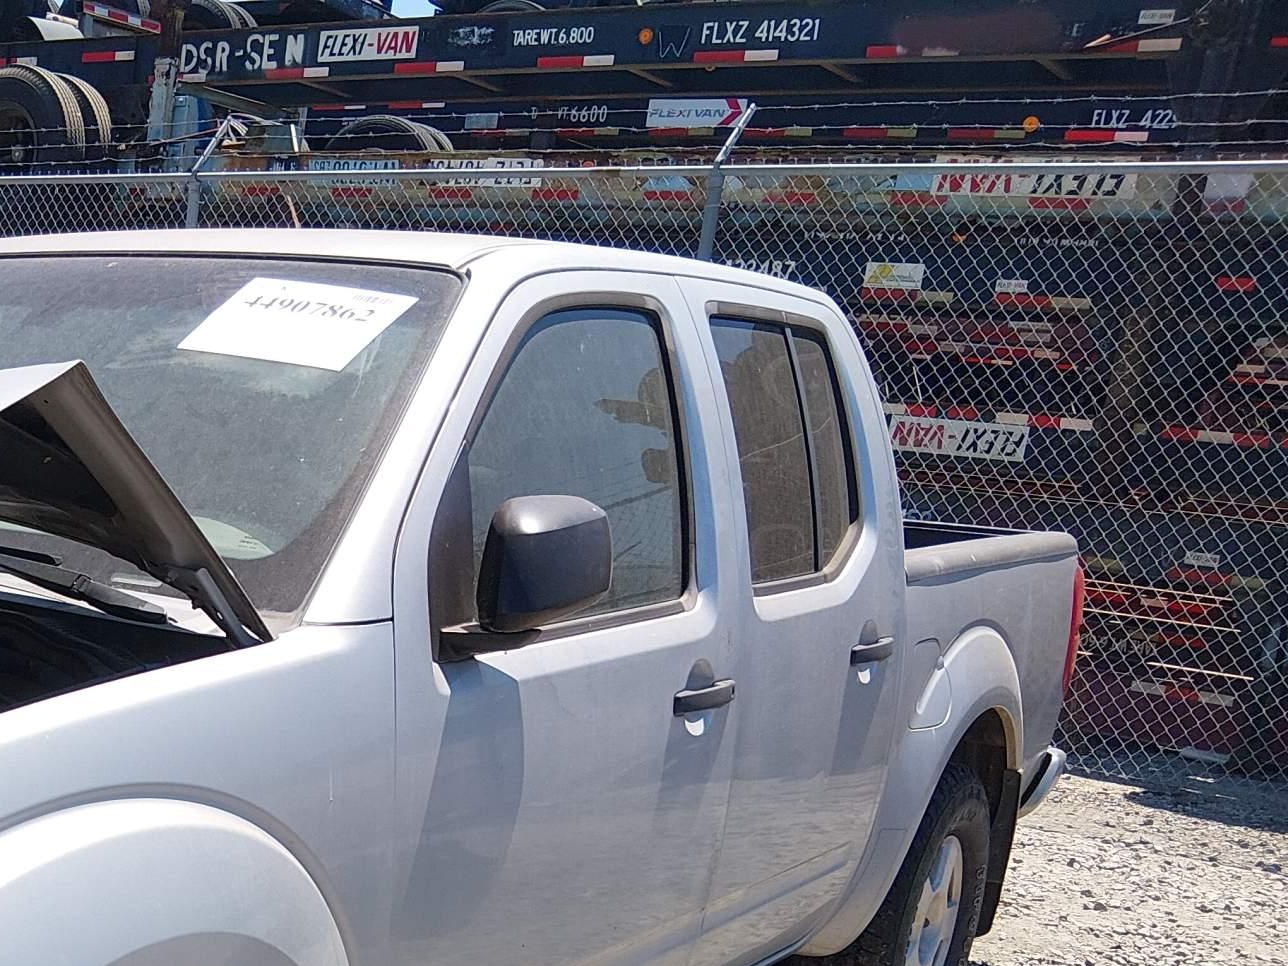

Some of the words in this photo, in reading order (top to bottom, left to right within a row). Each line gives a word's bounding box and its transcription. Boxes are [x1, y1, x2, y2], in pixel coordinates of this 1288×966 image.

[320, 30, 417, 58] FLEXI-VAN
[700, 20, 749, 45] FLXZ
[754, 18, 821, 42] 414321
[1092, 109, 1130, 129] FLXZ
[244, 295, 376, 323] 44907862
[891, 420, 1028, 458] FLEXI-VAN
